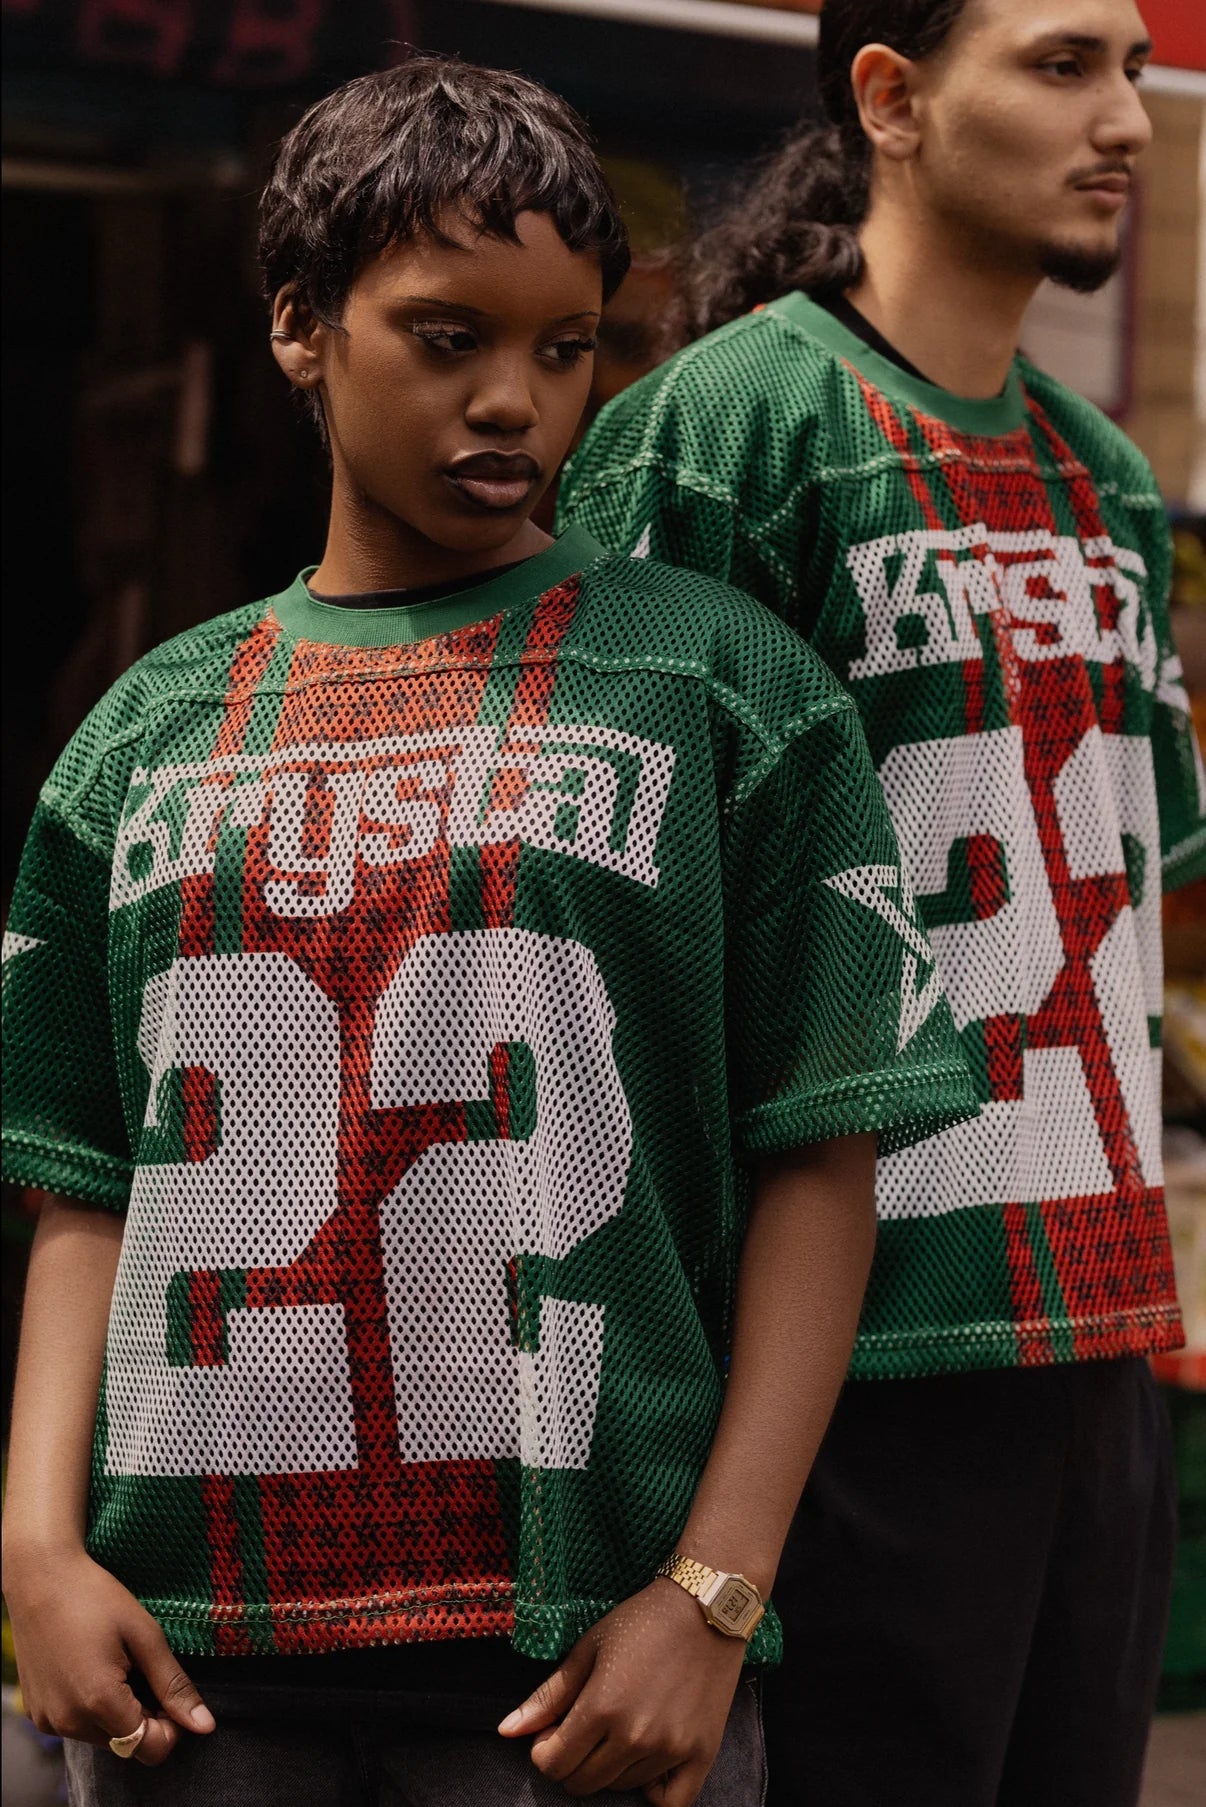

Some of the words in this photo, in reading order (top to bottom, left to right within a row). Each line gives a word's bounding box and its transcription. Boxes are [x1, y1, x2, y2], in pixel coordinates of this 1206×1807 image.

[846, 522, 1158, 692] Krstal
[108, 725, 676, 918] Krystal
[875, 724, 1164, 1221] 22
[104, 927, 633, 1476] 22
